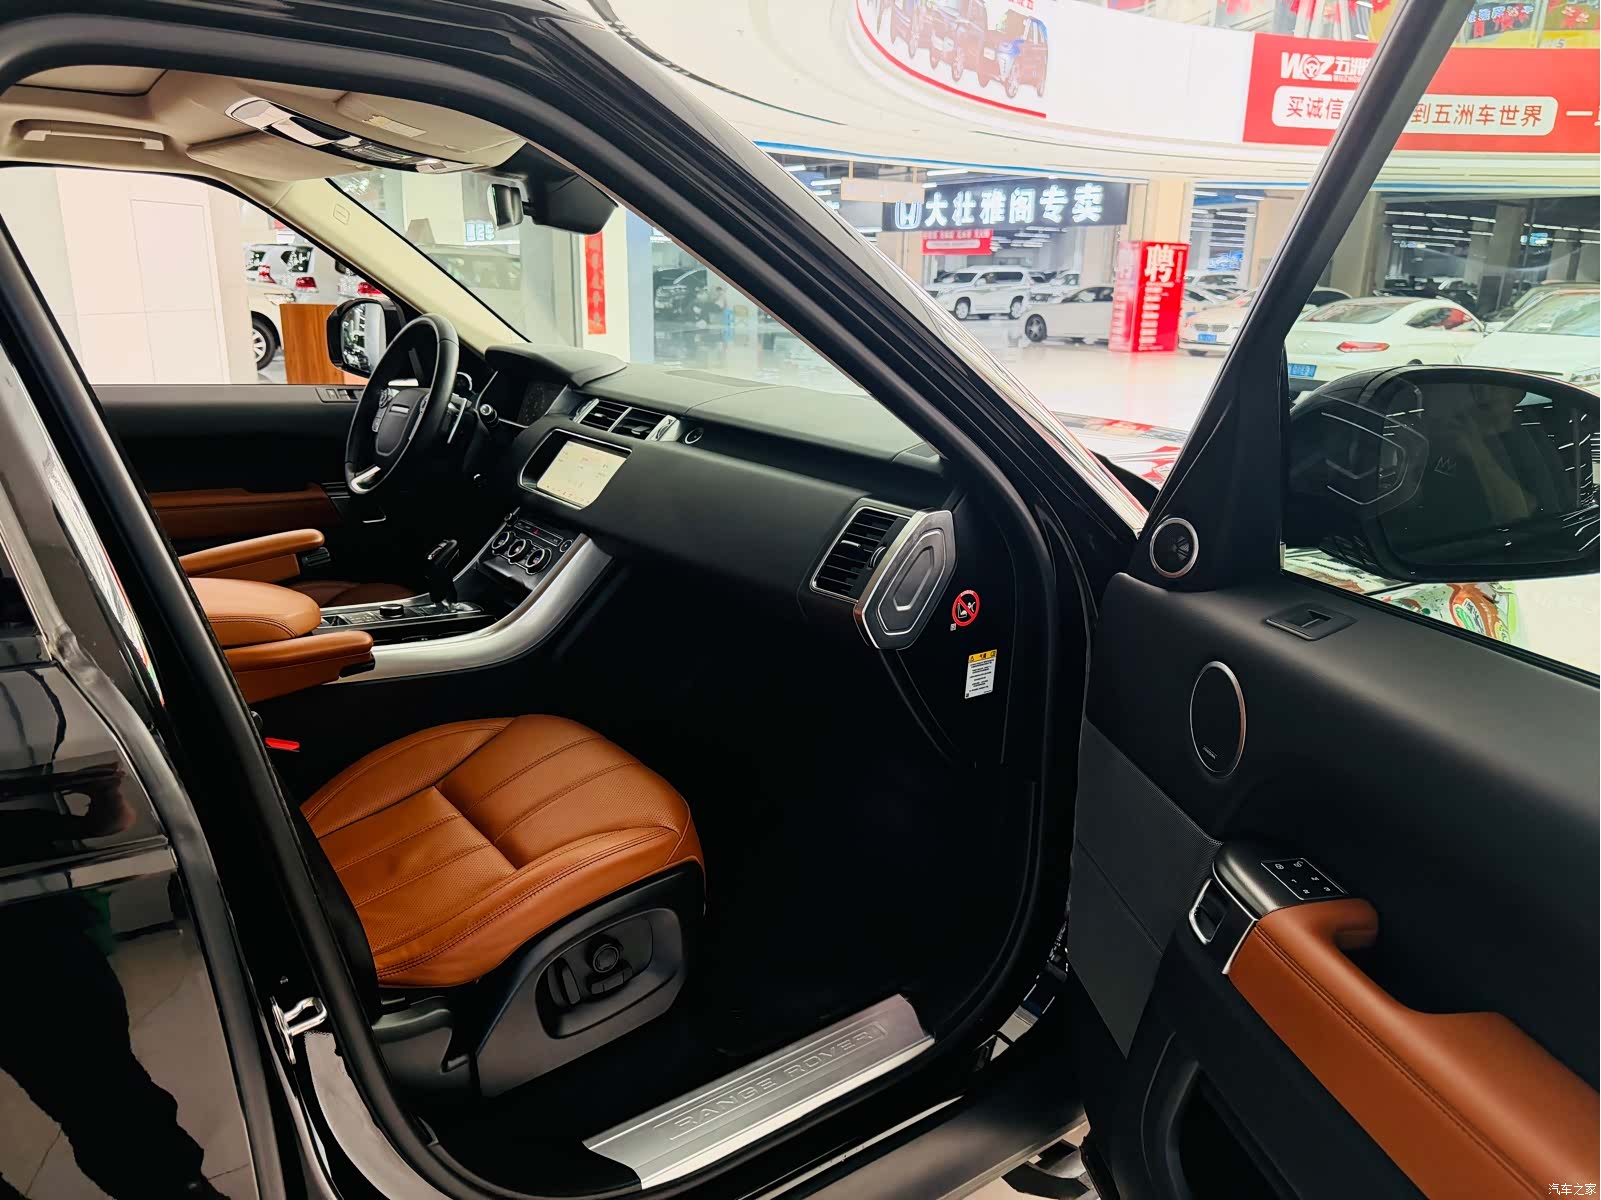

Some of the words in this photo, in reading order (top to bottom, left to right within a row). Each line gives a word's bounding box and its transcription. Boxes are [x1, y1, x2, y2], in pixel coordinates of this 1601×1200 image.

[1286, 95, 1345, 120] 买诚信
[1410, 102, 1543, 127] 到五洲车世界
[924, 183, 1103, 227] 大壮雅阁专卖
[1144, 244, 1175, 282] 聘
[673, 1077, 777, 1129] RANGE
[783, 1031, 873, 1077] ROVER
